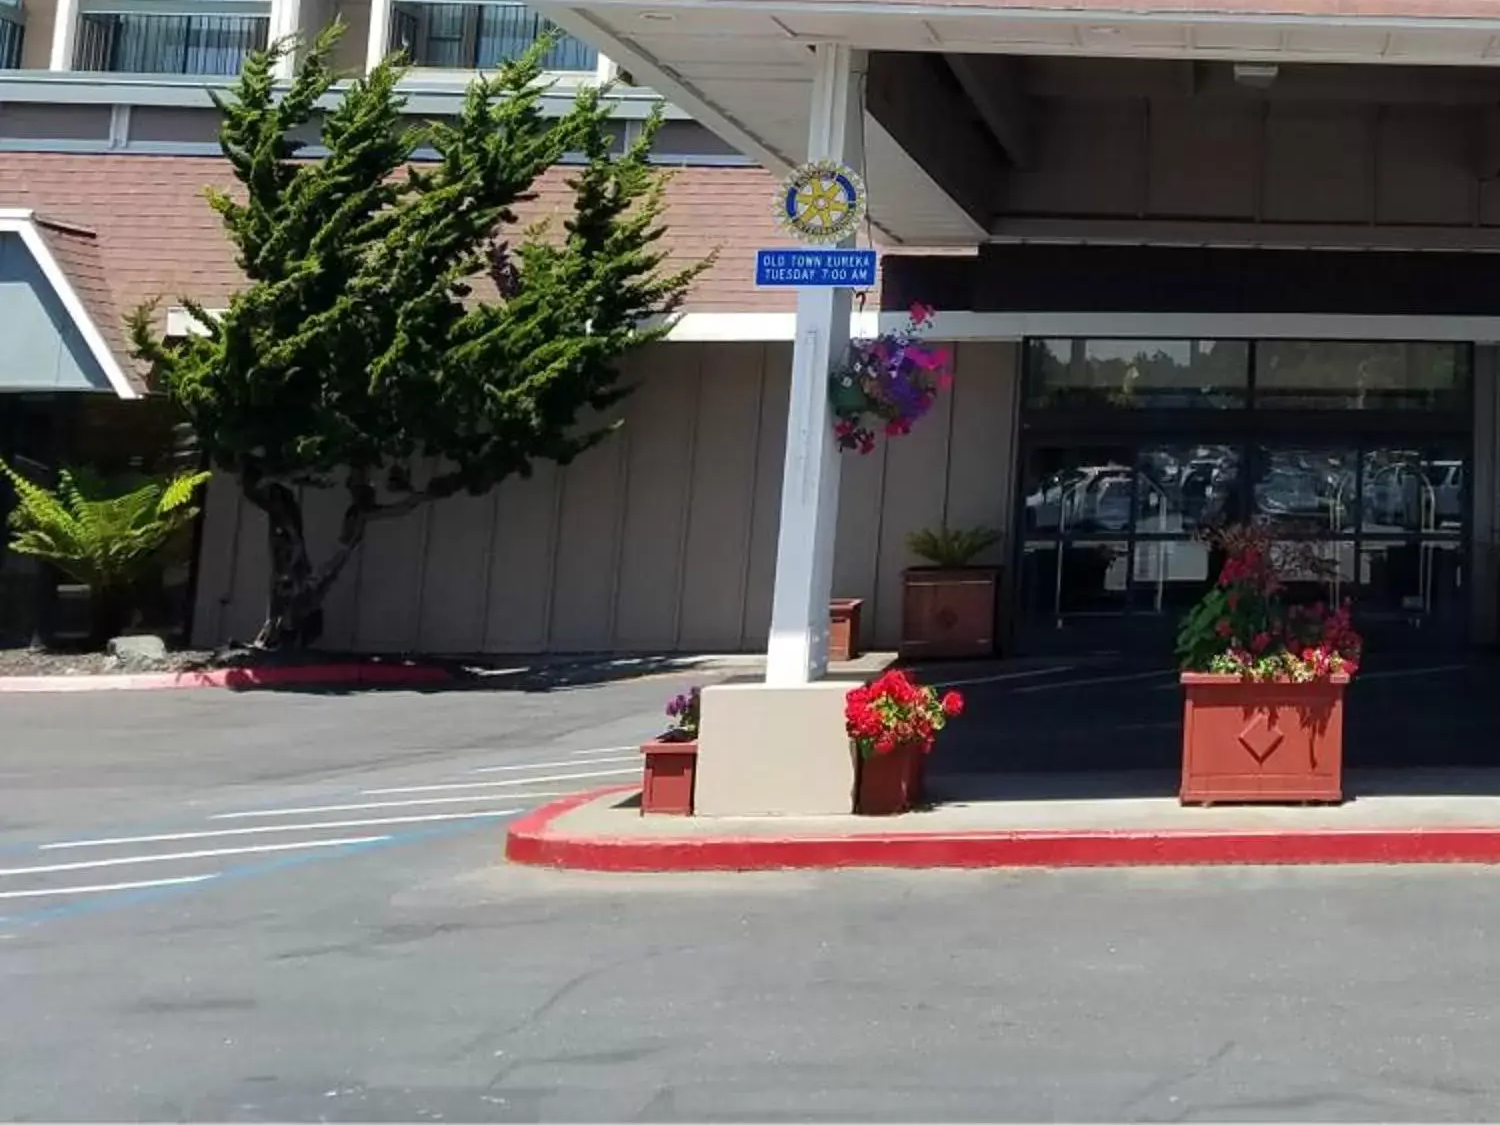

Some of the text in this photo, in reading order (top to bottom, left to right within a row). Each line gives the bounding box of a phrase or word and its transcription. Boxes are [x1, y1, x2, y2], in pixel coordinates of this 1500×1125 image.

[763, 255, 870, 268] OLD TOWN EUREKA
[765, 268, 816, 280] TUESDAY
[851, 269, 868, 280] AM
